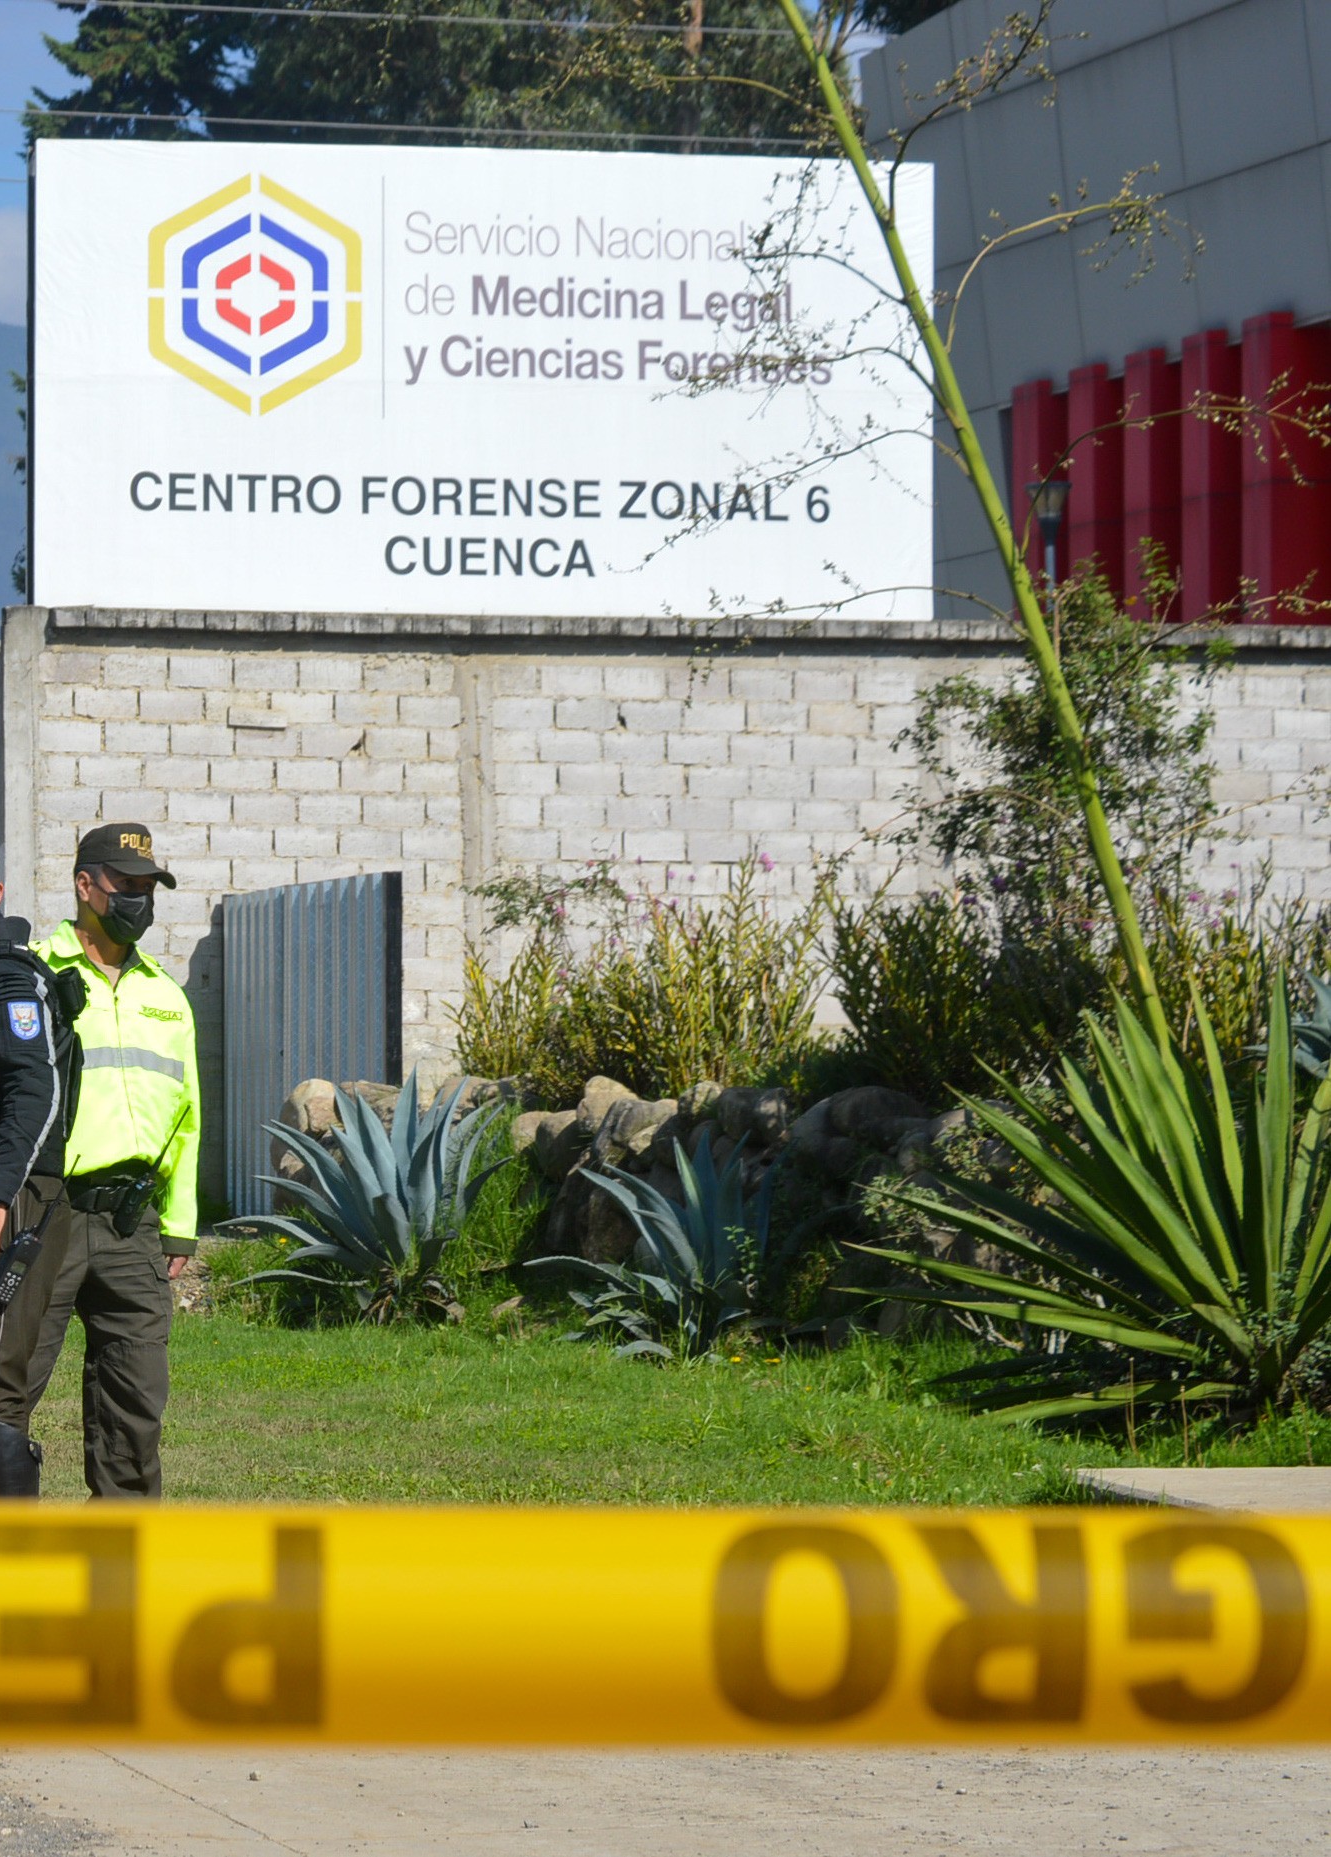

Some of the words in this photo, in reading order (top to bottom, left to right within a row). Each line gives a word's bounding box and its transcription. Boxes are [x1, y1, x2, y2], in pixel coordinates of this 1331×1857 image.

[404, 210, 560, 258] Servicio
[575, 215, 745, 262] Nacional
[404, 273, 456, 316] de
[471, 274, 665, 320] Medicina
[678, 280, 792, 332] Legal
[403, 344, 429, 385] y
[439, 334, 624, 380] Ciencias
[637, 340, 833, 385] Forenses
[129, 471, 342, 515] CENTRO
[361, 475, 602, 519] FORENSE
[618, 480, 790, 523] ZONAL
[806, 484, 831, 524] 6
[384, 535, 596, 578] CUENCA
